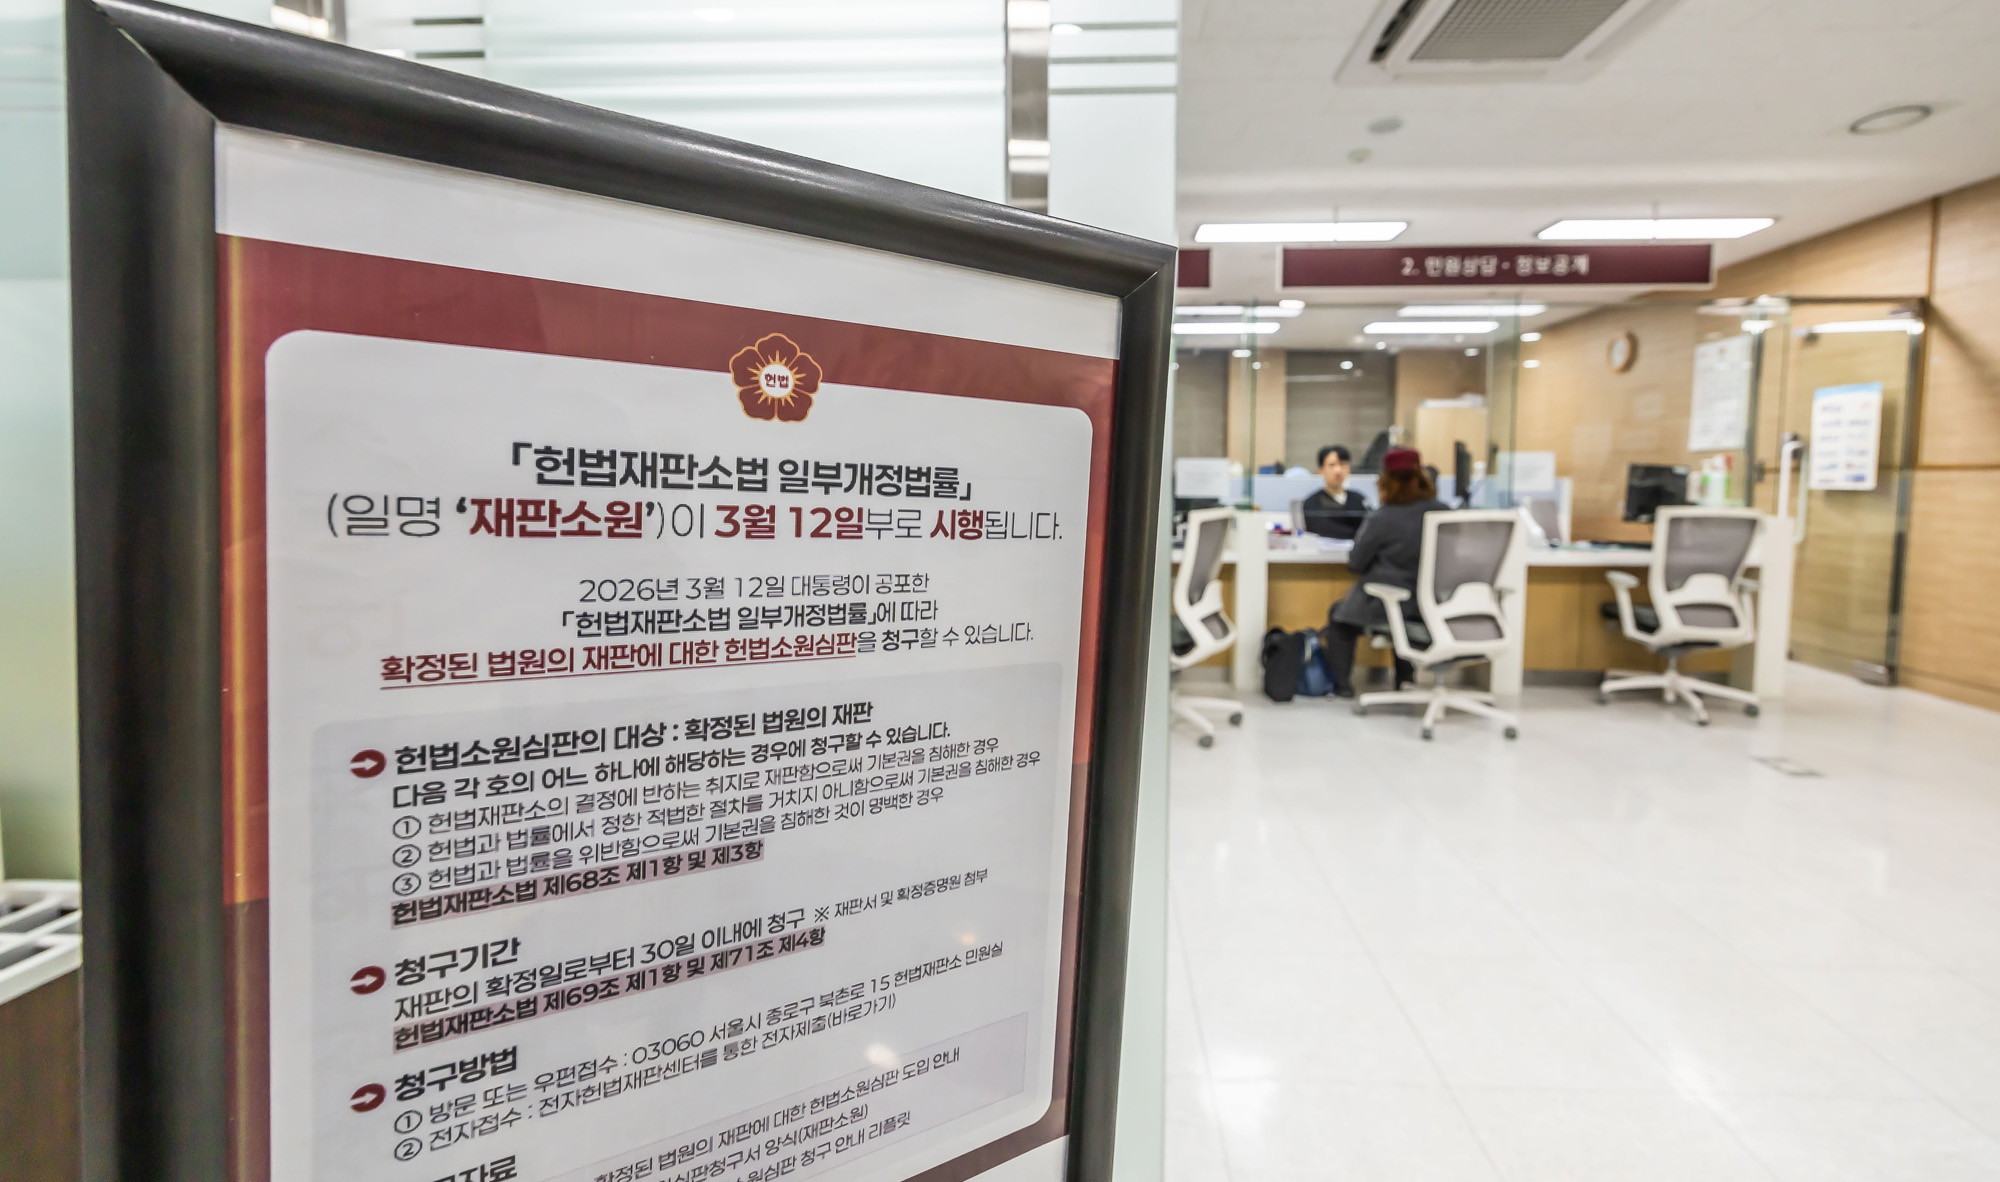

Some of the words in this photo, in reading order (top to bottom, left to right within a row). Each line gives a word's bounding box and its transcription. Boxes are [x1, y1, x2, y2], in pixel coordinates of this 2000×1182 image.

[1401, 257, 1420, 276] 2.
[764, 372, 790, 389] 헌법
[511, 441, 768, 492] 「헌법재판소법
[778, 458, 972, 501] 일부개정법률」
[328, 493, 440, 537] (일명
[714, 503, 776, 540] 3월
[789, 506, 923, 540] 12일부로
[930, 508, 1063, 541] 시행됩니다.
[563, 606, 730, 638] 「헌법재판소법
[737, 601, 896, 630] 일부개정법률」에
[901, 600, 938, 622] 따라
[579, 577, 679, 602] 2026년
[686, 576, 725, 600] 3월
[735, 575, 784, 598] 12일
[791, 573, 869, 597] 대통령이
[875, 573, 930, 594] 공포한
[380, 652, 478, 683] 확정된
[488, 647, 574, 676] 법원의
[582, 642, 662, 671] 재판에
[669, 639, 719, 665] 대한
[724, 631, 877, 662] 헌법소원심판을
[881, 627, 938, 651] 청구할
[942, 626, 960, 646] 수
[964, 622, 1034, 645] 있습니다.
[393, 780, 447, 808] 다음
[454, 777, 480, 799] 각
[485, 770, 535, 798] 호의
[542, 766, 589, 789] 어느
[594, 756, 660, 783] 하나에
[665, 748, 746, 773] 해당하는
[751, 738, 806, 763] 경우에
[810, 731, 863, 755] 청구할
[865, 730, 882, 748] 수
[886, 721, 950, 745] 있습니다.
[394, 728, 606, 775] 헌법소원심판의
[614, 722, 667, 749] 대상
[684, 713, 756, 742] 확정된
[762, 706, 827, 734] 법원의
[831, 701, 874, 726] 재판
[428, 796, 569, 835] 헌법재판소의
[575, 788, 638, 814] 결정에
[643, 781, 701, 804] 반하는
[705, 771, 760, 795] 취지로
[765, 757, 863, 786] 재판함으로써
[867, 748, 925, 771] 기본권을
[929, 741, 970, 762] 침해한
[973, 737, 999, 756] 경우
[428, 832, 501, 863] 헌법과
[506, 819, 595, 850] 법률에서
[601, 812, 642, 836] 정한
[647, 802, 706, 827] 적법한
[709, 793, 764, 819] 절차를
[768, 785, 818, 809] 거치지
[822, 770, 914, 800] 아니함으로써
[917, 761, 972, 785] 기본권을
[974, 754, 1014, 776] 침해한
[1016, 750, 1041, 768] 경우
[428, 859, 501, 891] 헌법과
[506, 847, 573, 877] 법률을
[578, 827, 699, 865] 위반함으로써
[705, 815, 776, 843] 기본권을
[780, 805, 830, 831] 침해한
[834, 799, 865, 821] 것이
[869, 791, 913, 814] 명백한
[916, 786, 943, 806] 경우
[392, 879, 537, 926] 헌법재판소법
[542, 865, 621, 897] 제68조
[626, 854, 683, 882] 제1항
[687, 849, 707, 870] 및
[711, 840, 763, 866] 제3항
[394, 981, 478, 1021] 재판의
[485, 946, 635, 997] 확정일로부터
[640, 932, 695, 964] 30일
[701, 917, 762, 949] 이내에
[767, 908, 805, 934] 청구
[834, 894, 877, 917] 재판서
[880, 890, 893, 907] 및
[897, 874, 961, 900] 확정증명원
[964, 868, 988, 887] 첨부
[395, 937, 521, 986] 청구기간
[394, 996, 537, 1050] 헌법재판소법
[543, 977, 620, 1012] 제69조
[625, 963, 682, 992] 제1항
[686, 956, 705, 978] 및
[710, 939, 775, 971] 제71조
[778, 926, 826, 953] 제4항
[429, 1093, 476, 1124] 방문
[482, 1083, 528, 1109] 또는
[533, 1055, 619, 1092] 우편접수
[632, 1030, 705, 1064] 03060
[709, 1012, 761, 1043] 서울시
[766, 996, 815, 1026] 종로구
[819, 982, 865, 1008] 북촌로
[870, 975, 890, 993] 15
[894, 954, 962, 987] 헌법재판소
[965, 941, 1003, 966] 민원실
[394, 1045, 517, 1101] 청구방법
[429, 1107, 522, 1151] 전자접수
[539, 1048, 718, 1118] 전자헌법재판센터를
[723, 1035, 758, 1062] 통한
[761, 993, 896, 1050] 전자제출(바로가기)
[658, 1136, 713, 1171] 법원의
[718, 1115, 769, 1149] 재판에
[773, 1103, 806, 1128] 대한
[809, 1068, 899, 1115] 헌법소원심판
[902, 1057, 929, 1081] 도입
[933, 1046, 960, 1070] 안내
[765, 1104, 868, 1156] 양식(재판소원)
[800, 1142, 831, 1167] 청구
[834, 1128, 865, 1154] 안내
[868, 1111, 911, 1140] 리플릿
